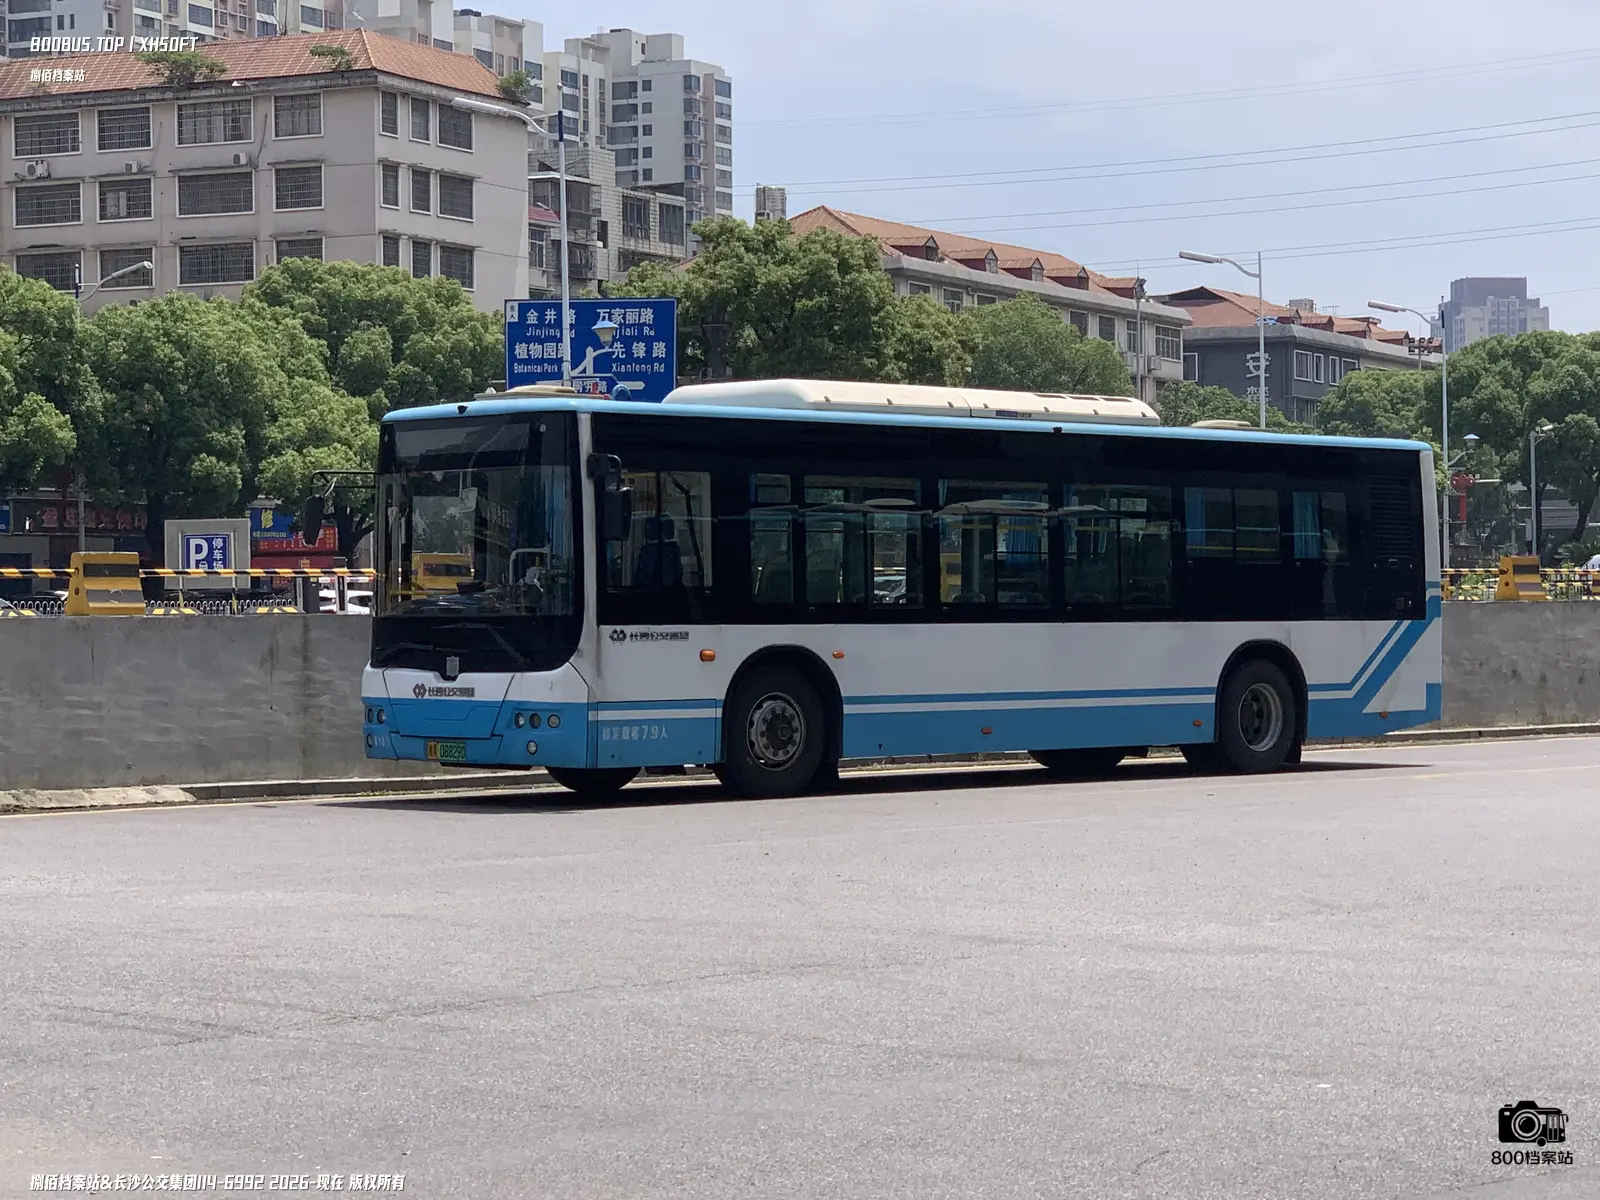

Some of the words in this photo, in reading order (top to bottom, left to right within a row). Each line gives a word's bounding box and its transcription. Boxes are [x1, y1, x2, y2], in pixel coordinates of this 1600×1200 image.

[597, 307, 654, 325] 万家丽路
[526, 326, 560, 339] Jinjing
[611, 341, 667, 359] 先锋路
[513, 362, 543, 373] Botanical
[544, 362, 559, 373] Park
[611, 362, 652, 374] Xianfeng
[653, 362, 665, 373] Rd
[212, 538, 223, 570] 停车场
